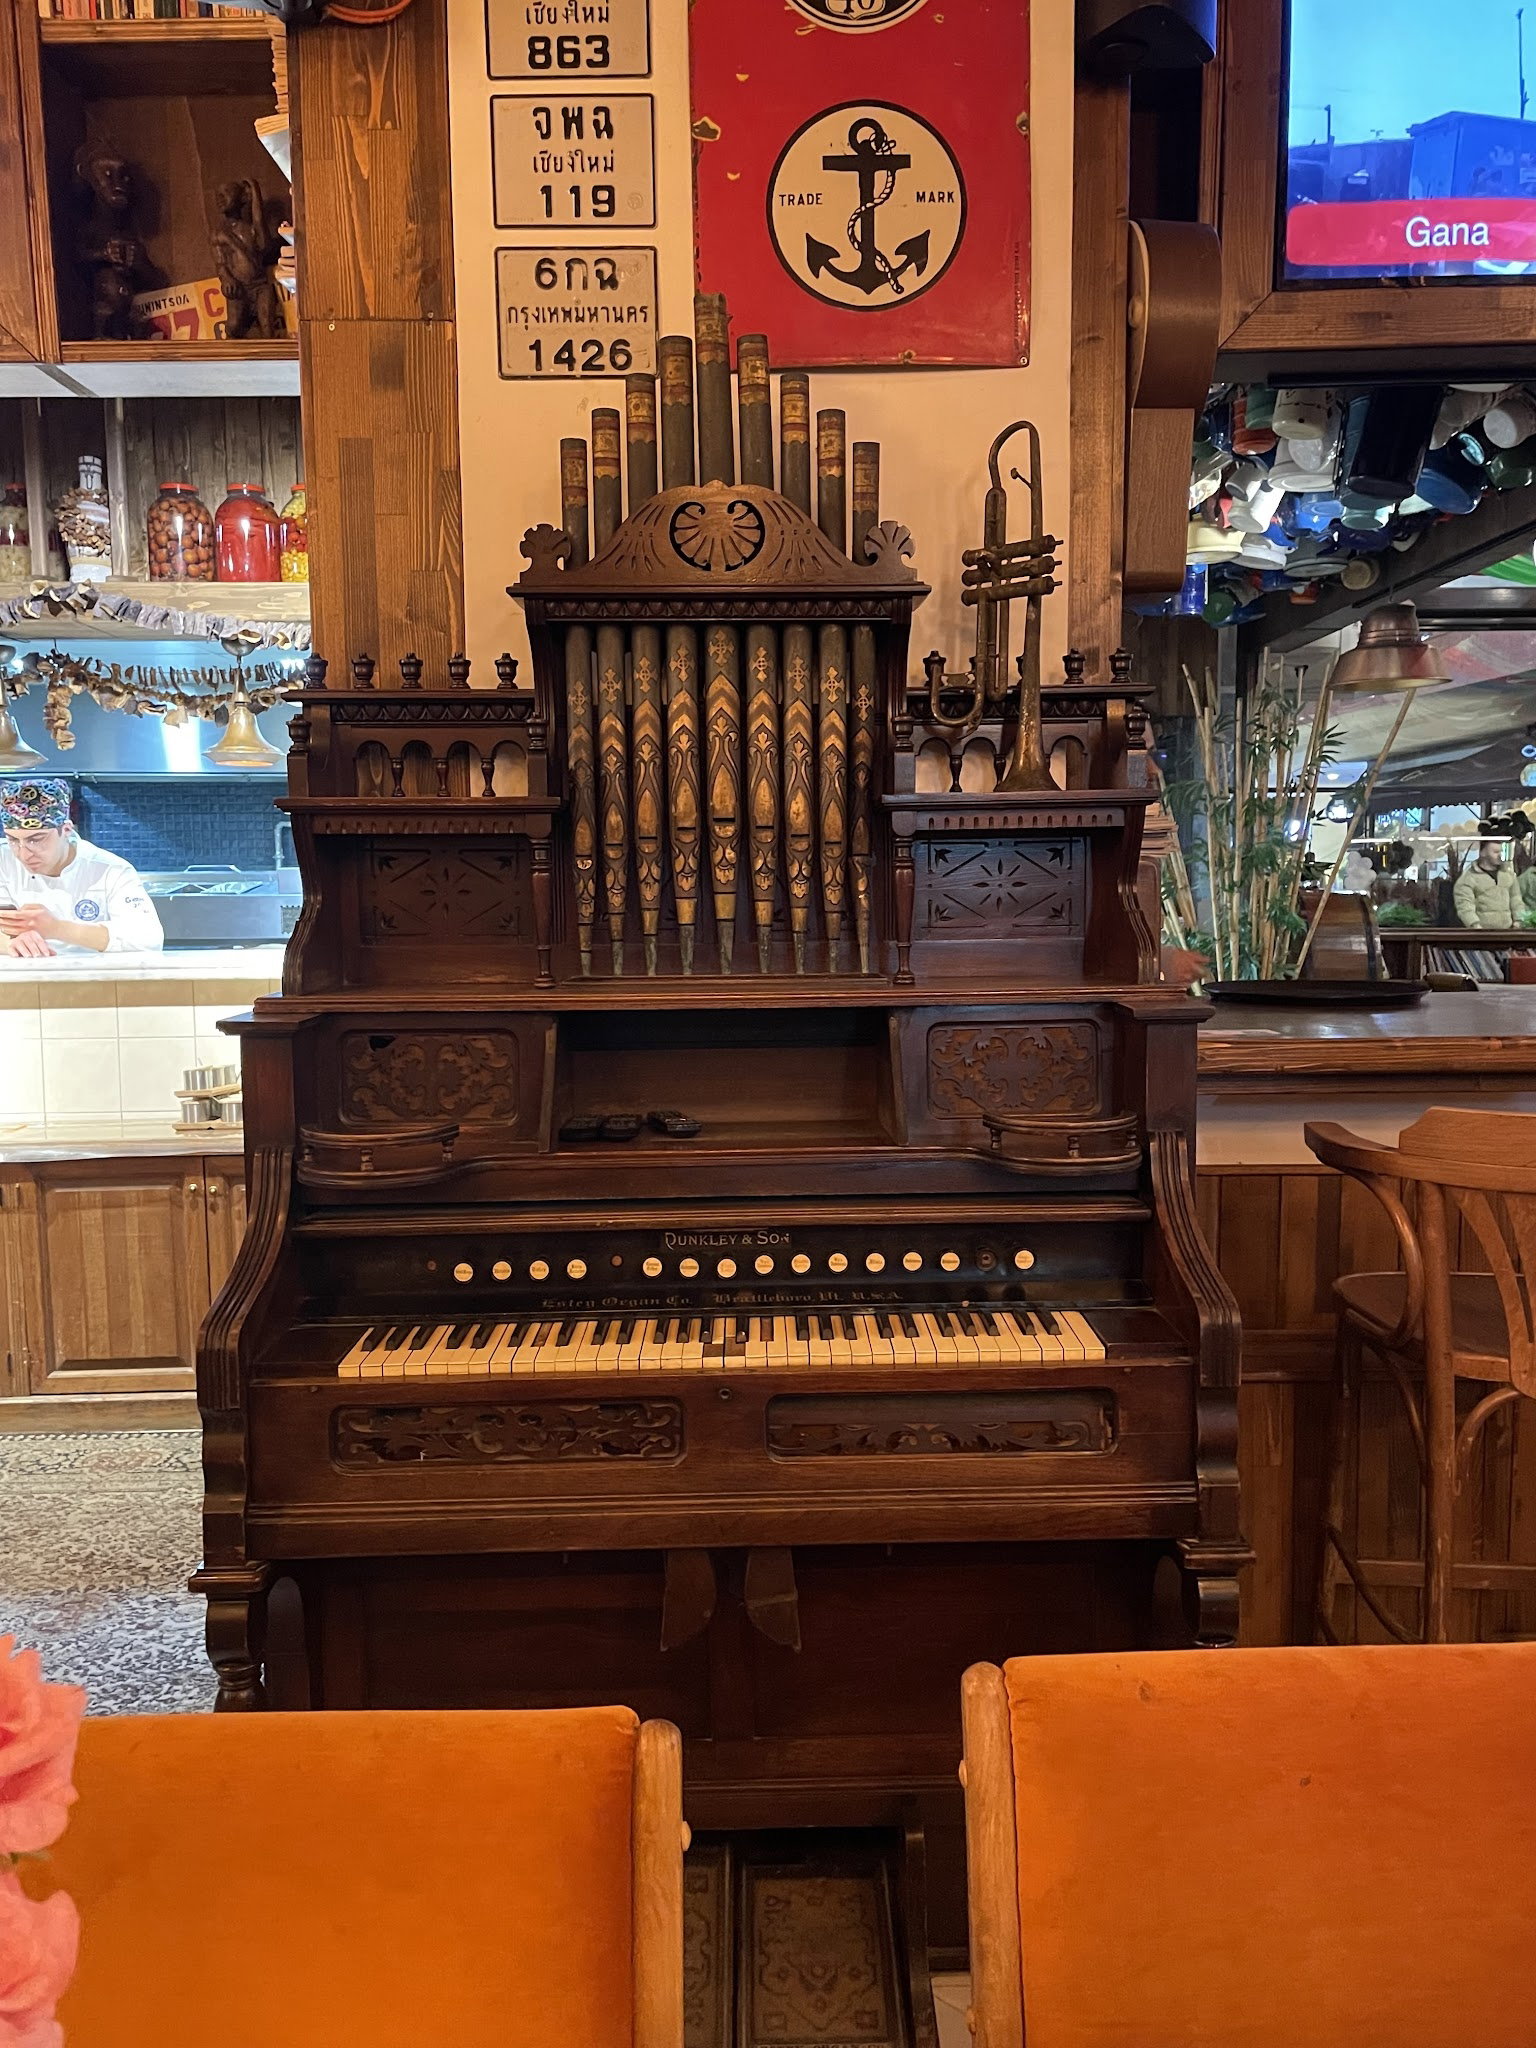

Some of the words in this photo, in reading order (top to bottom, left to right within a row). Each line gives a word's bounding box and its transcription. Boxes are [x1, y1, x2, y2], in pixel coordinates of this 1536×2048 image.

[528, 34, 610, 69] 863
[533, 149, 614, 173] เชียงใหม่
[540, 185, 615, 218] 119
[778, 192, 823, 207] TRADE
[915, 191, 955, 204] MARK
[1405, 216, 1490, 248] Gana
[507, 305, 649, 331] กรุงเทพมหานคร
[528, 338, 633, 372] 1426
[664, 1231, 738, 1250] DUNKLEY
[741, 1233, 753, 1245] &
